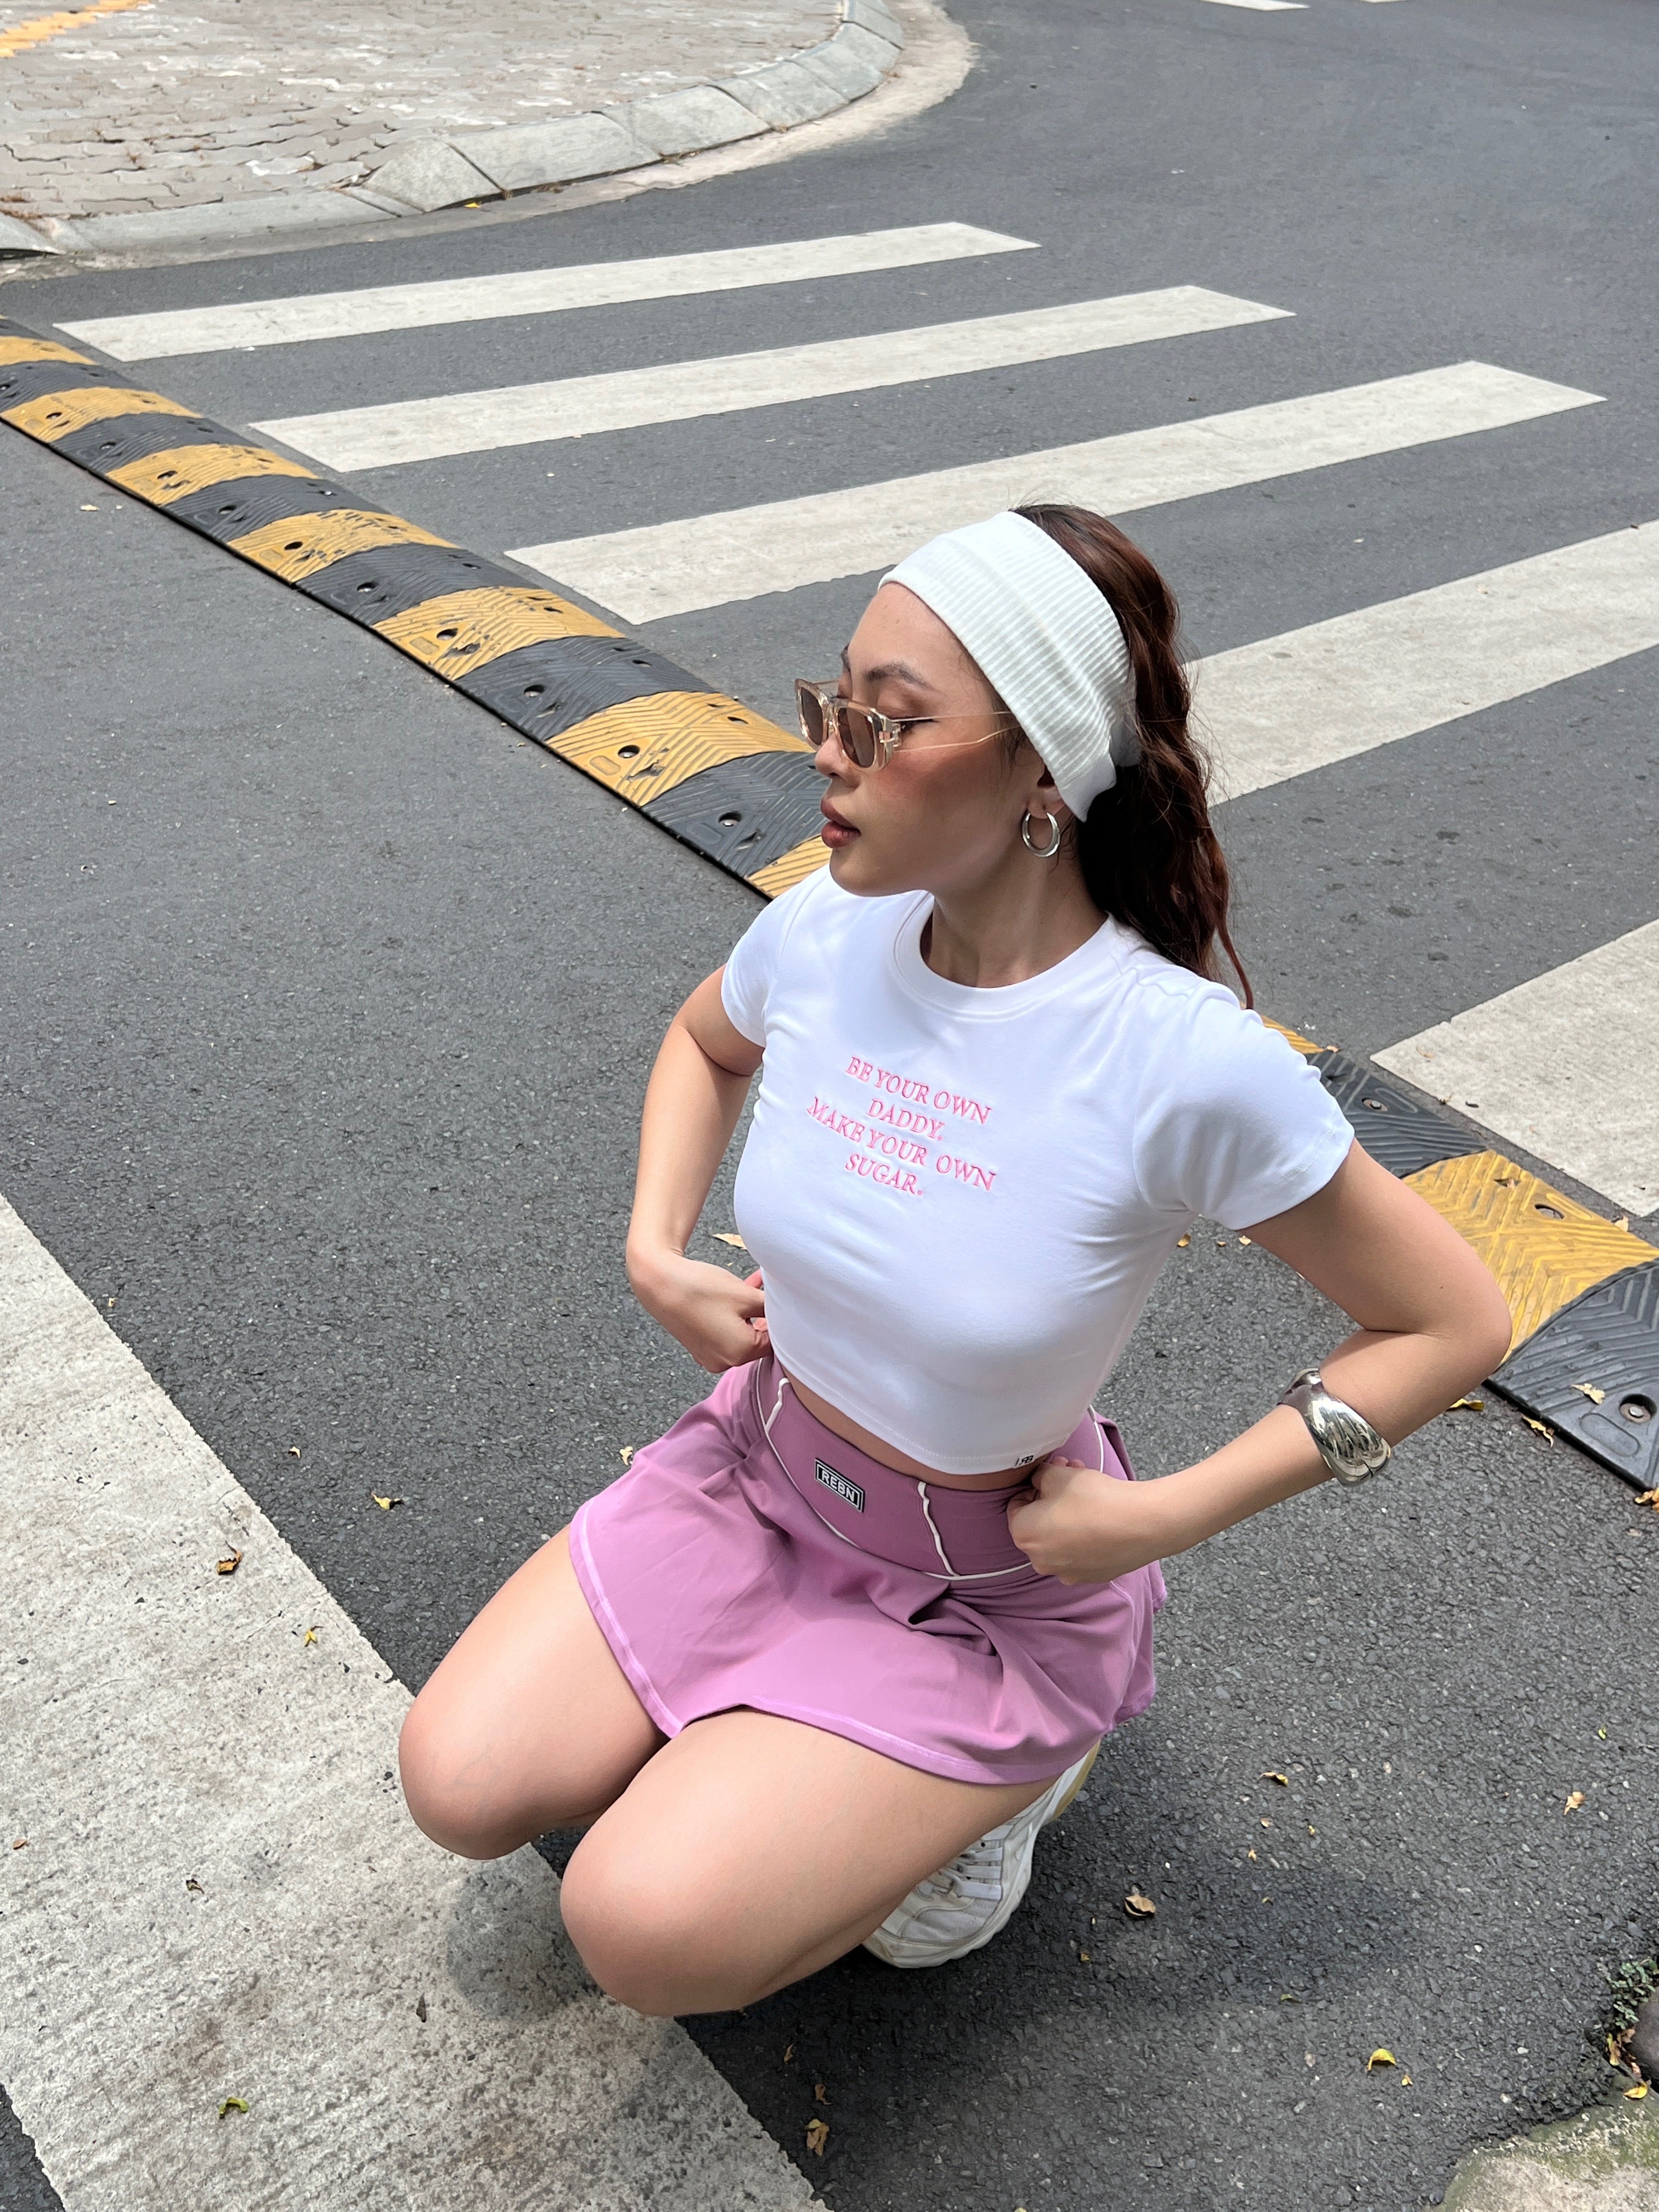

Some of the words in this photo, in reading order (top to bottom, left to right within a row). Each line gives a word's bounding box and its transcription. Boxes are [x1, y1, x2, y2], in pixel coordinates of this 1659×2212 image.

[845, 1056, 873, 1082] BE
[874, 1068, 930, 1104] YOUR
[934, 1091, 992, 1125] OWN
[866, 1098, 945, 1141] DADDY.
[806, 1096, 865, 1142] MAKE
[867, 1128, 929, 1166] YOUR
[936, 1155, 996, 1191] OWN
[845, 1153, 923, 1195] SUGAR.
[822, 1470, 855, 1502] REBN
